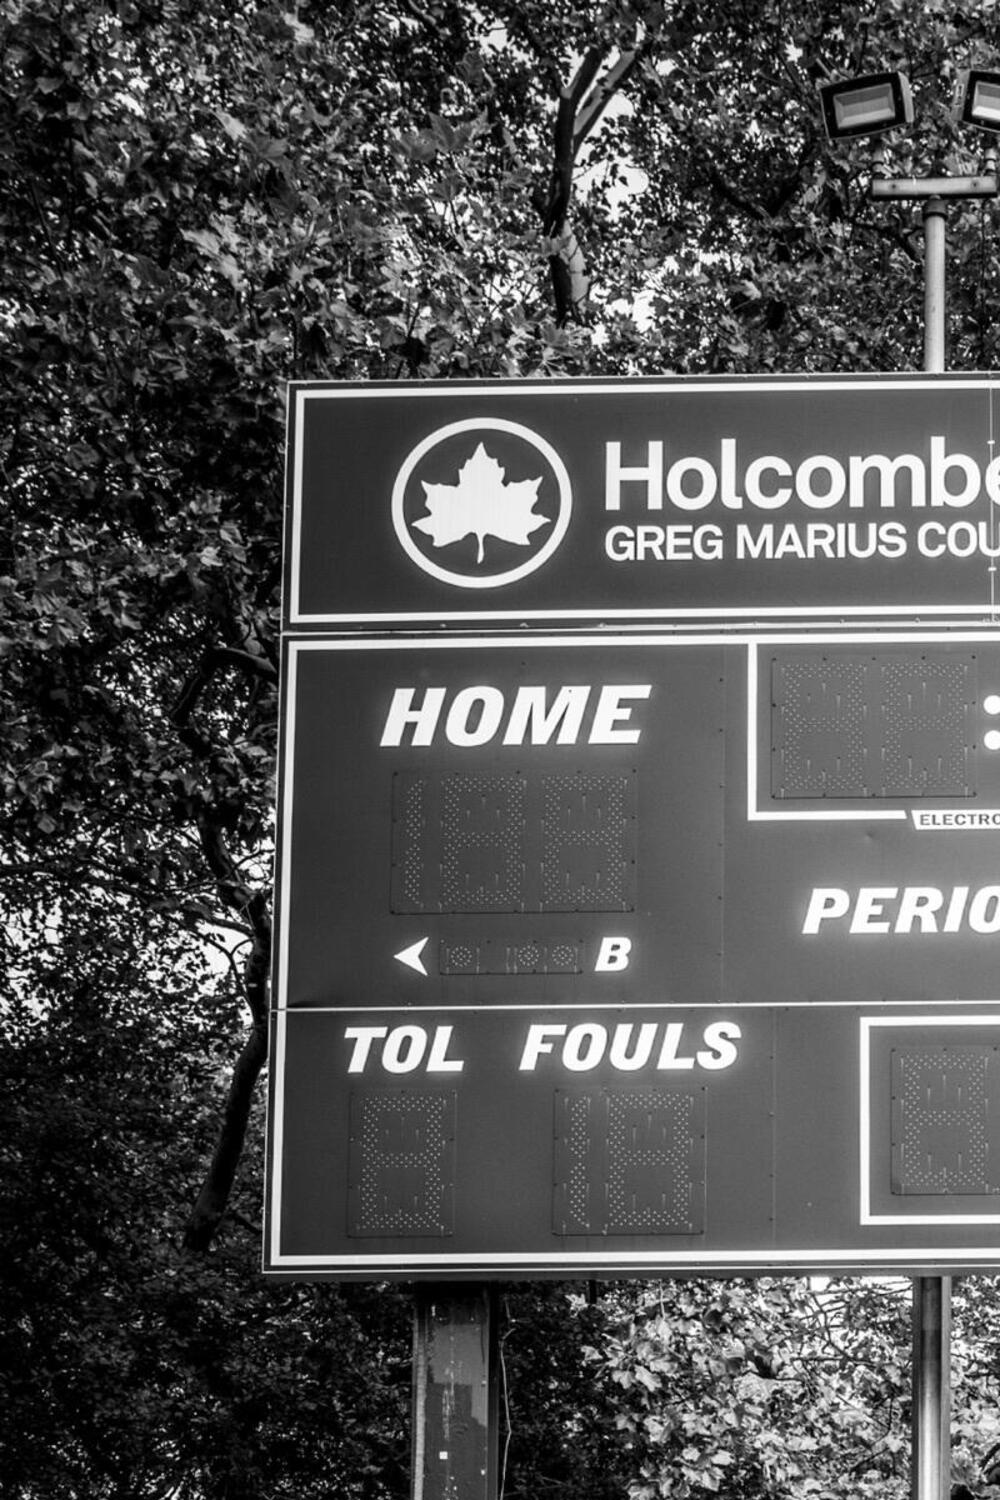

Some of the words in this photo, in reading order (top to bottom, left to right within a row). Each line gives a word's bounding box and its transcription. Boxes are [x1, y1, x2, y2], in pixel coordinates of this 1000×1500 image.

[605, 524, 723, 562] GREG
[736, 521, 907, 560] MARIUS
[379, 684, 653, 747] HOME
[594, 936, 633, 972] B
[344, 1025, 465, 1074] TOL
[518, 1020, 742, 1072] FOULS
